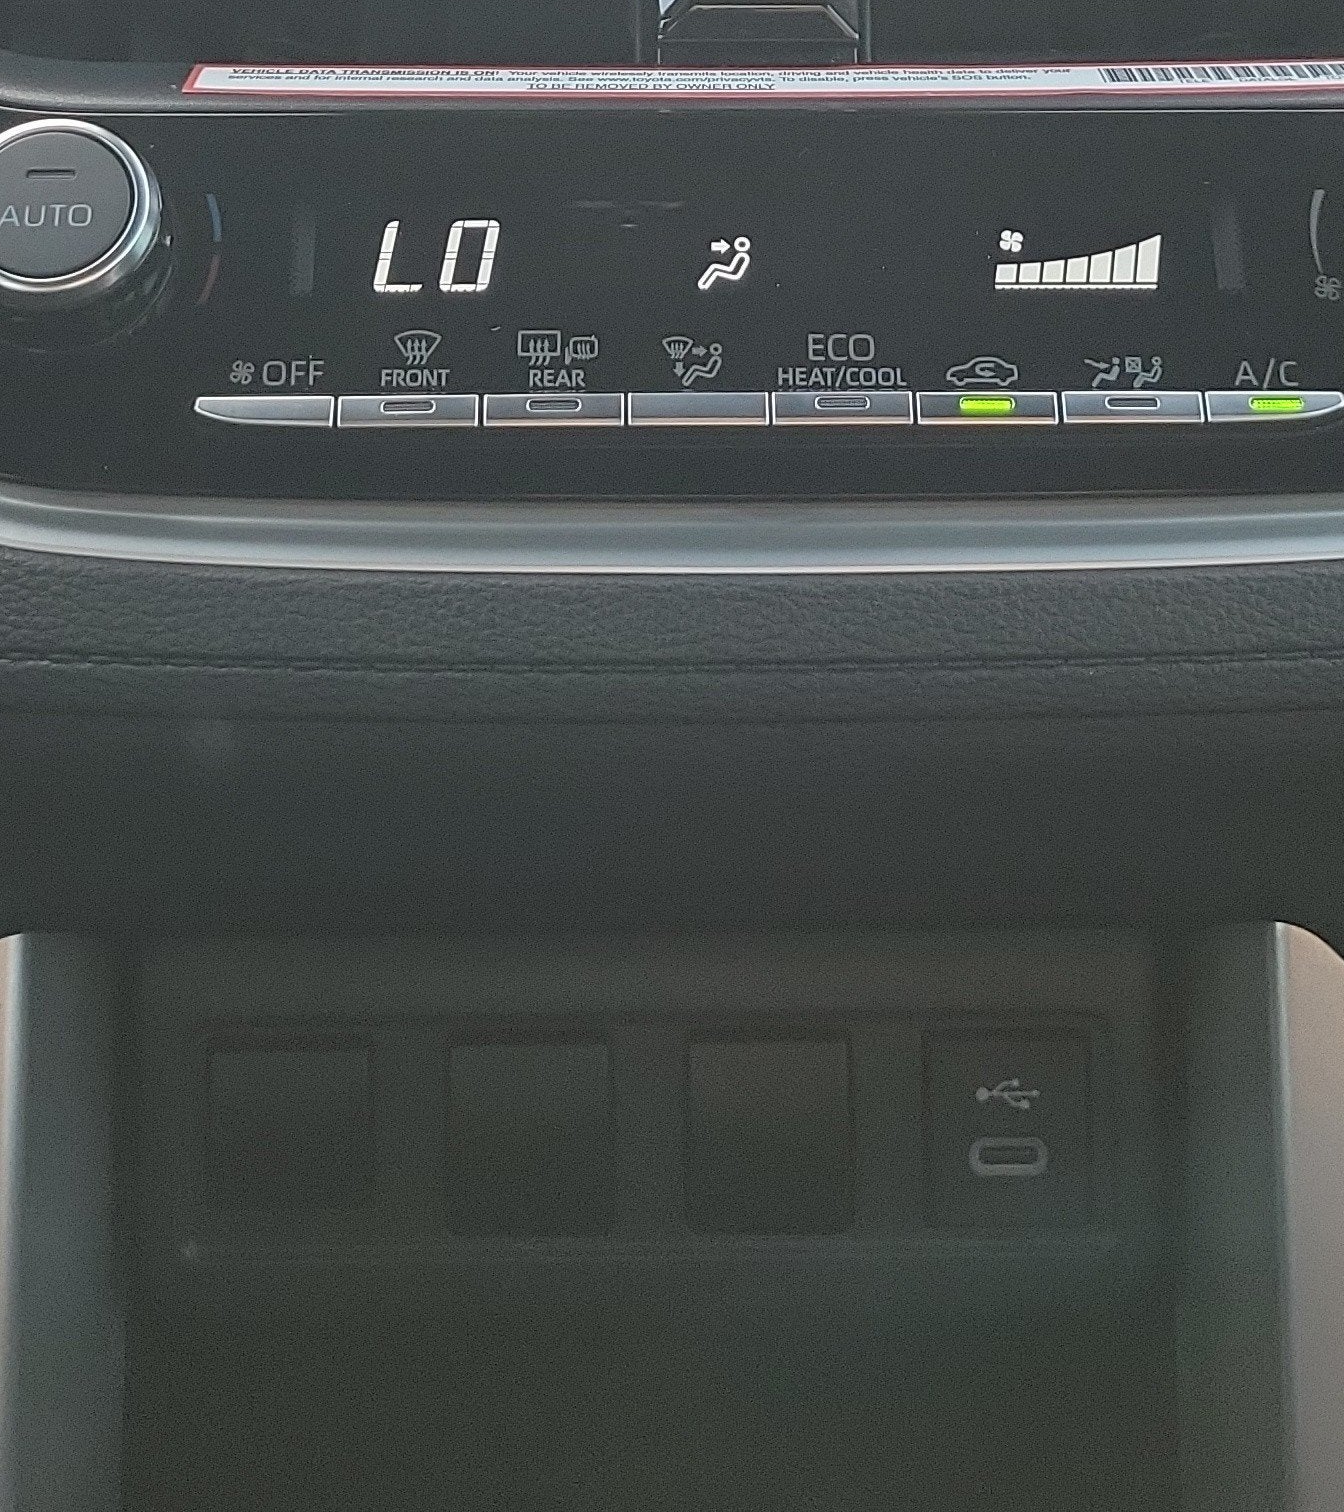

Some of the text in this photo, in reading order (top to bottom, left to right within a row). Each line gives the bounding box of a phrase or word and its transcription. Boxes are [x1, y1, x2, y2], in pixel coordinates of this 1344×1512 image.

[371, 219, 501, 293] LO
[807, 332, 875, 361] ECO
[261, 360, 325, 387] OFF
[380, 367, 450, 388] FRONT
[528, 367, 587, 388] REAR
[777, 365, 908, 387] HEAT/COOL
[1234, 358, 1300, 388] A/C
